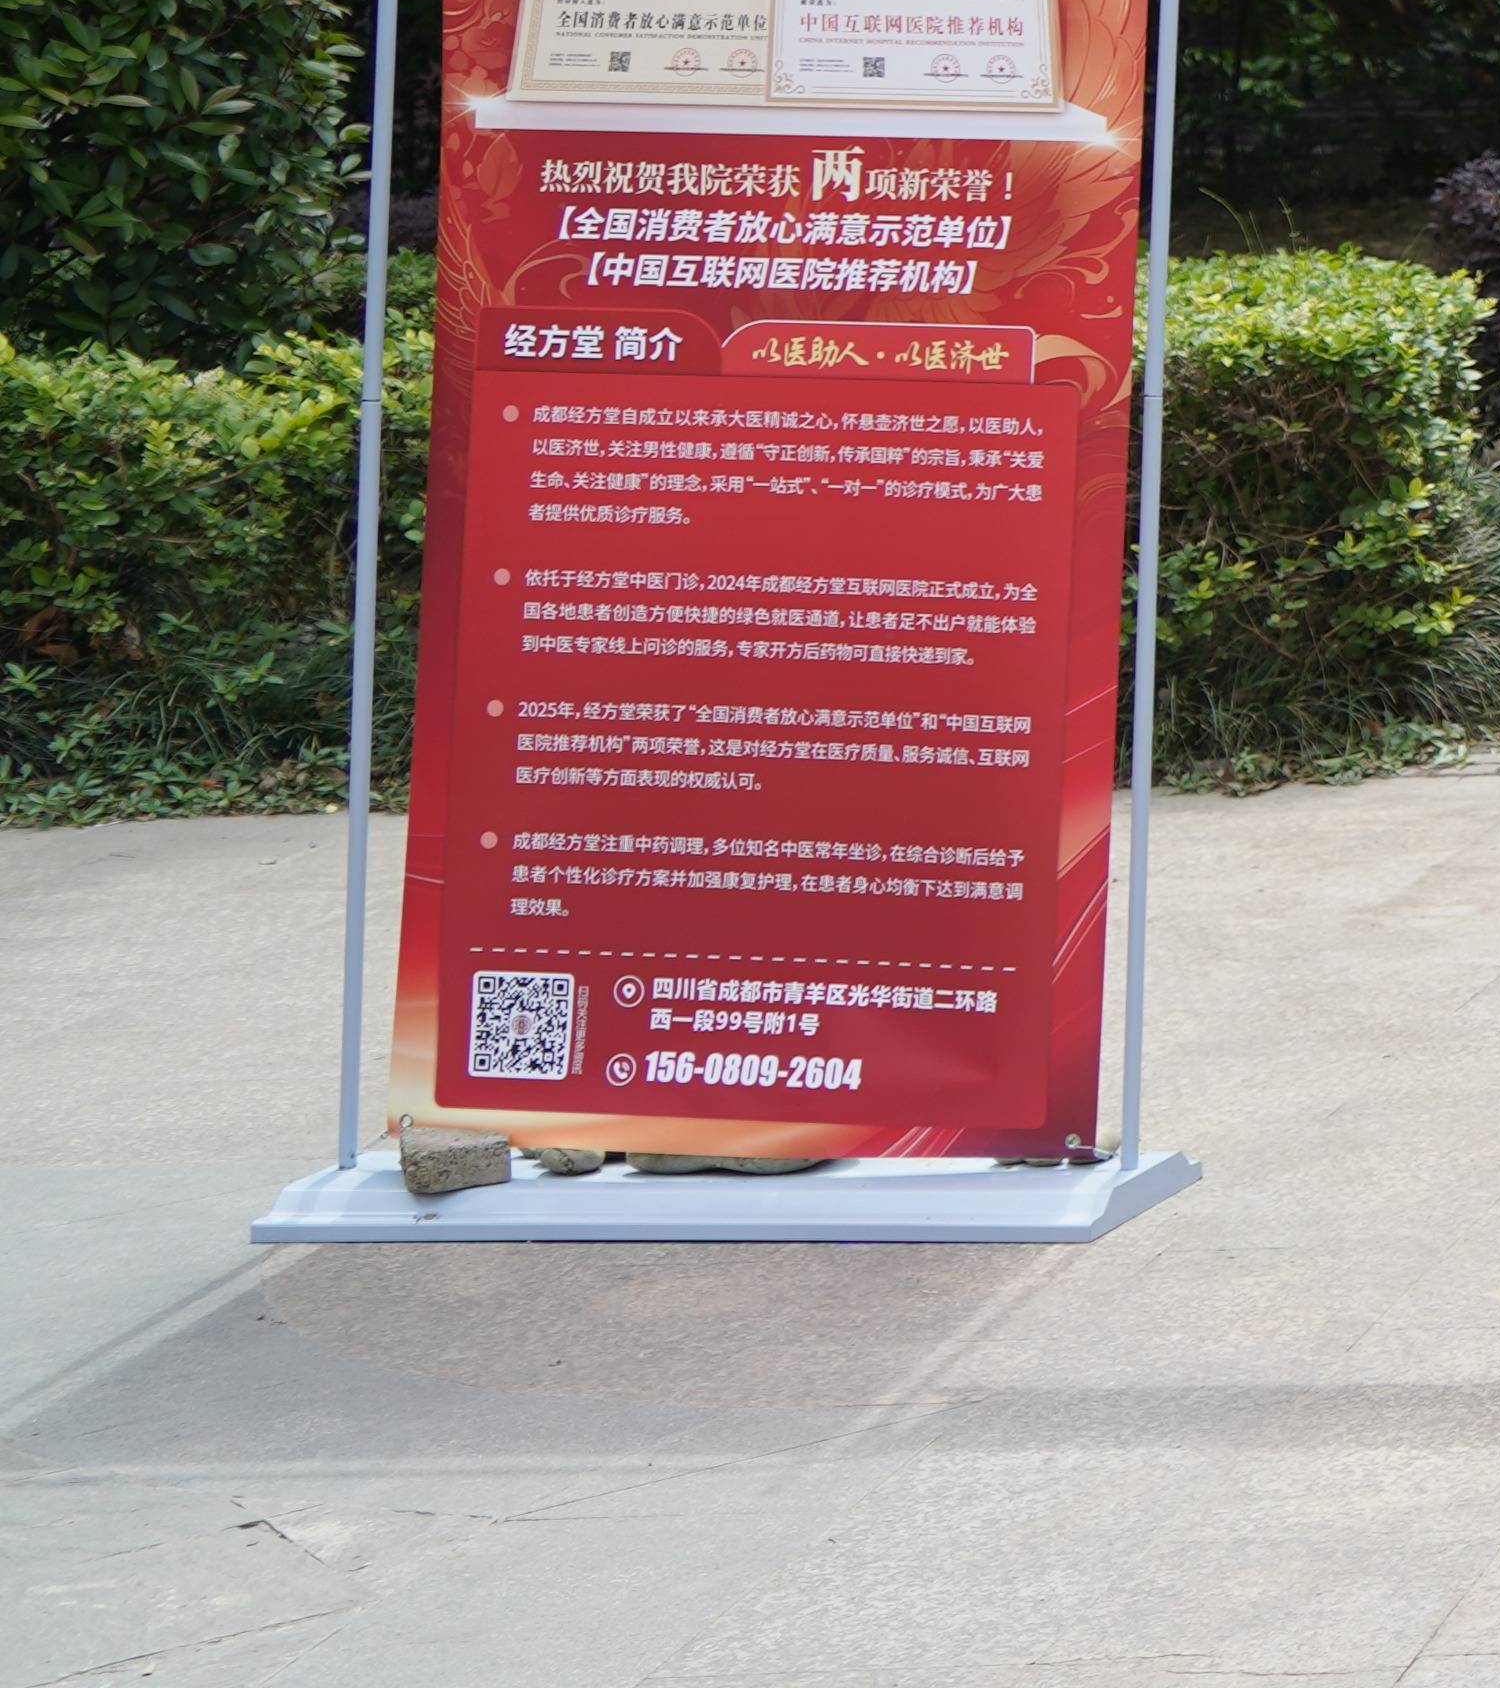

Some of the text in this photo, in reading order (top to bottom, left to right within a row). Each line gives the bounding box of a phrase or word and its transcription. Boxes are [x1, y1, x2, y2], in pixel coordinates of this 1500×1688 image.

[557, 11, 767, 32] 全国消费者放心满意示范单位
[800, 13, 1023, 36] 中国互联网医院推荐机构
[557, 206, 1010, 251] 【全国消费者放心满意示范单位】
[583, 250, 977, 296] 【中国互联网医院推荐机构】
[504, 323, 682, 362] 经方堂 简介
[528, 503, 691, 525] 者提供优质诊疗服务。
[515, 766, 762, 791] 医疗创新等方面表现的权威认可。
[510, 897, 569, 917] 理效果。
[652, 977, 998, 1013] 四川省成都市青羊区光华街道二环路
[649, 1007, 820, 1037] 西一段99号附1号
[644, 1051, 862, 1091] 156-0809-2604
